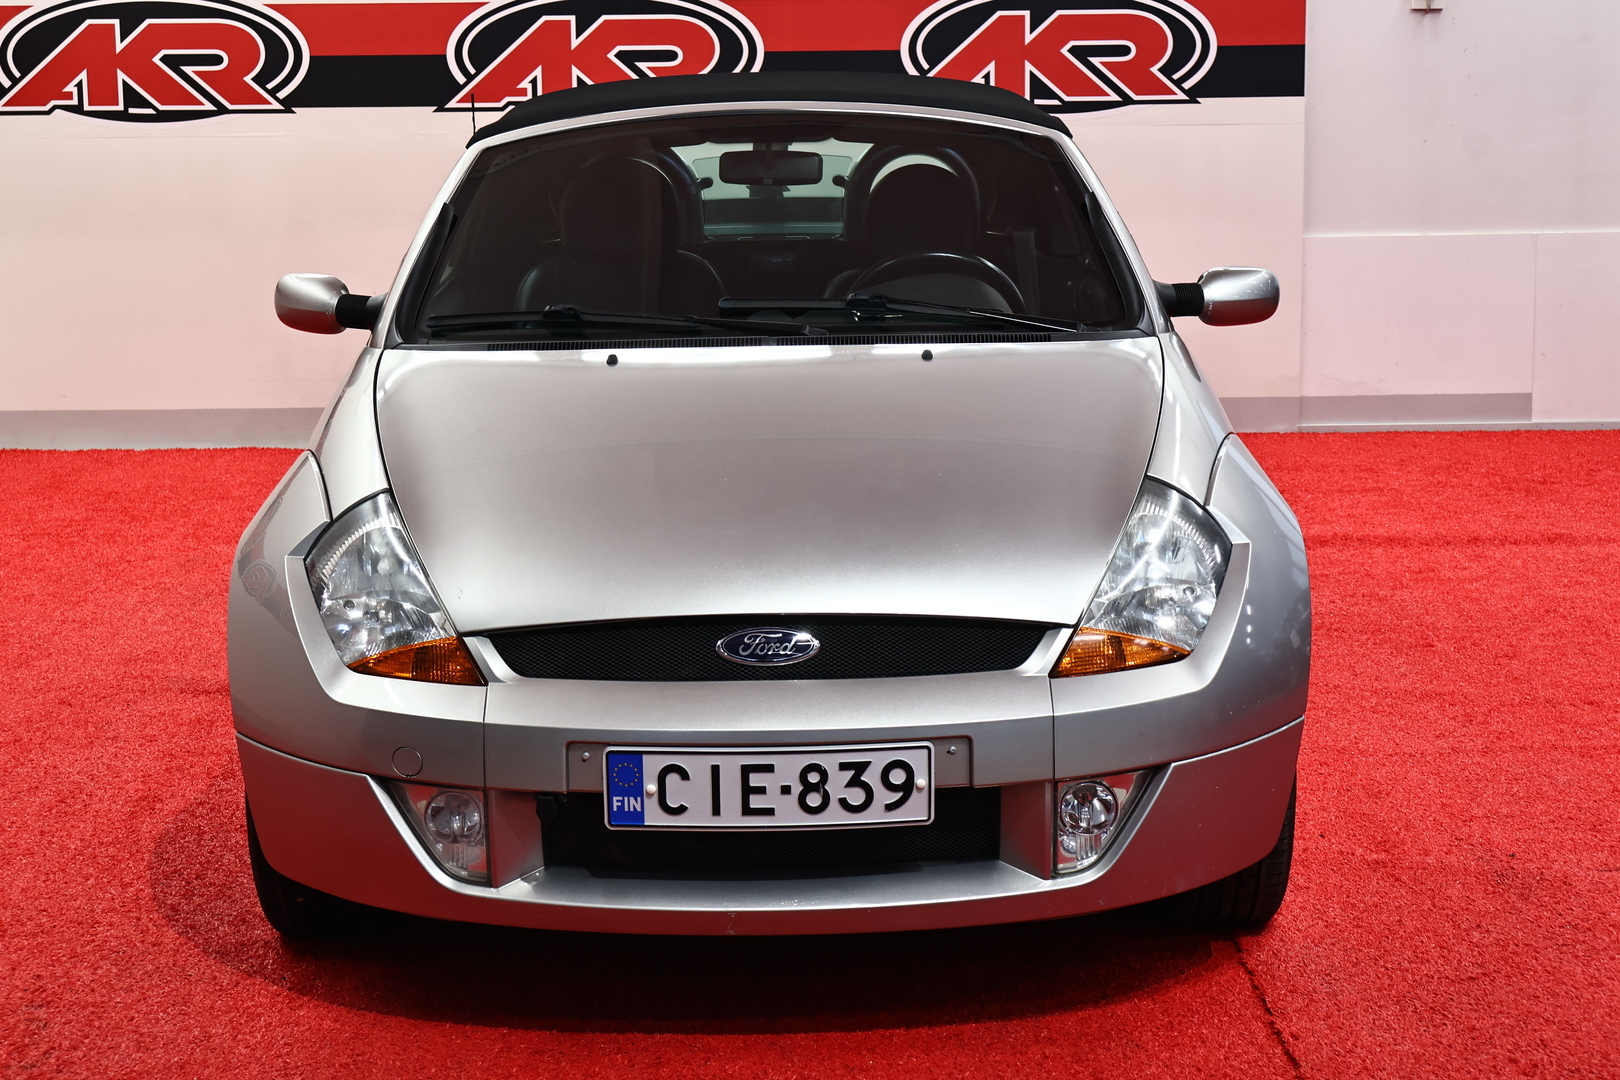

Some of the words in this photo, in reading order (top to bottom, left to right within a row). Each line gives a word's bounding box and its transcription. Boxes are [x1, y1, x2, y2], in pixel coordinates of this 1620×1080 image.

[0, 18, 286, 111] AKR
[925, 9, 1190, 102] AKR
[739, 632, 796, 656] Ford
[612, 796, 642, 812] FIN
[657, 759, 916, 817] CIE-839
